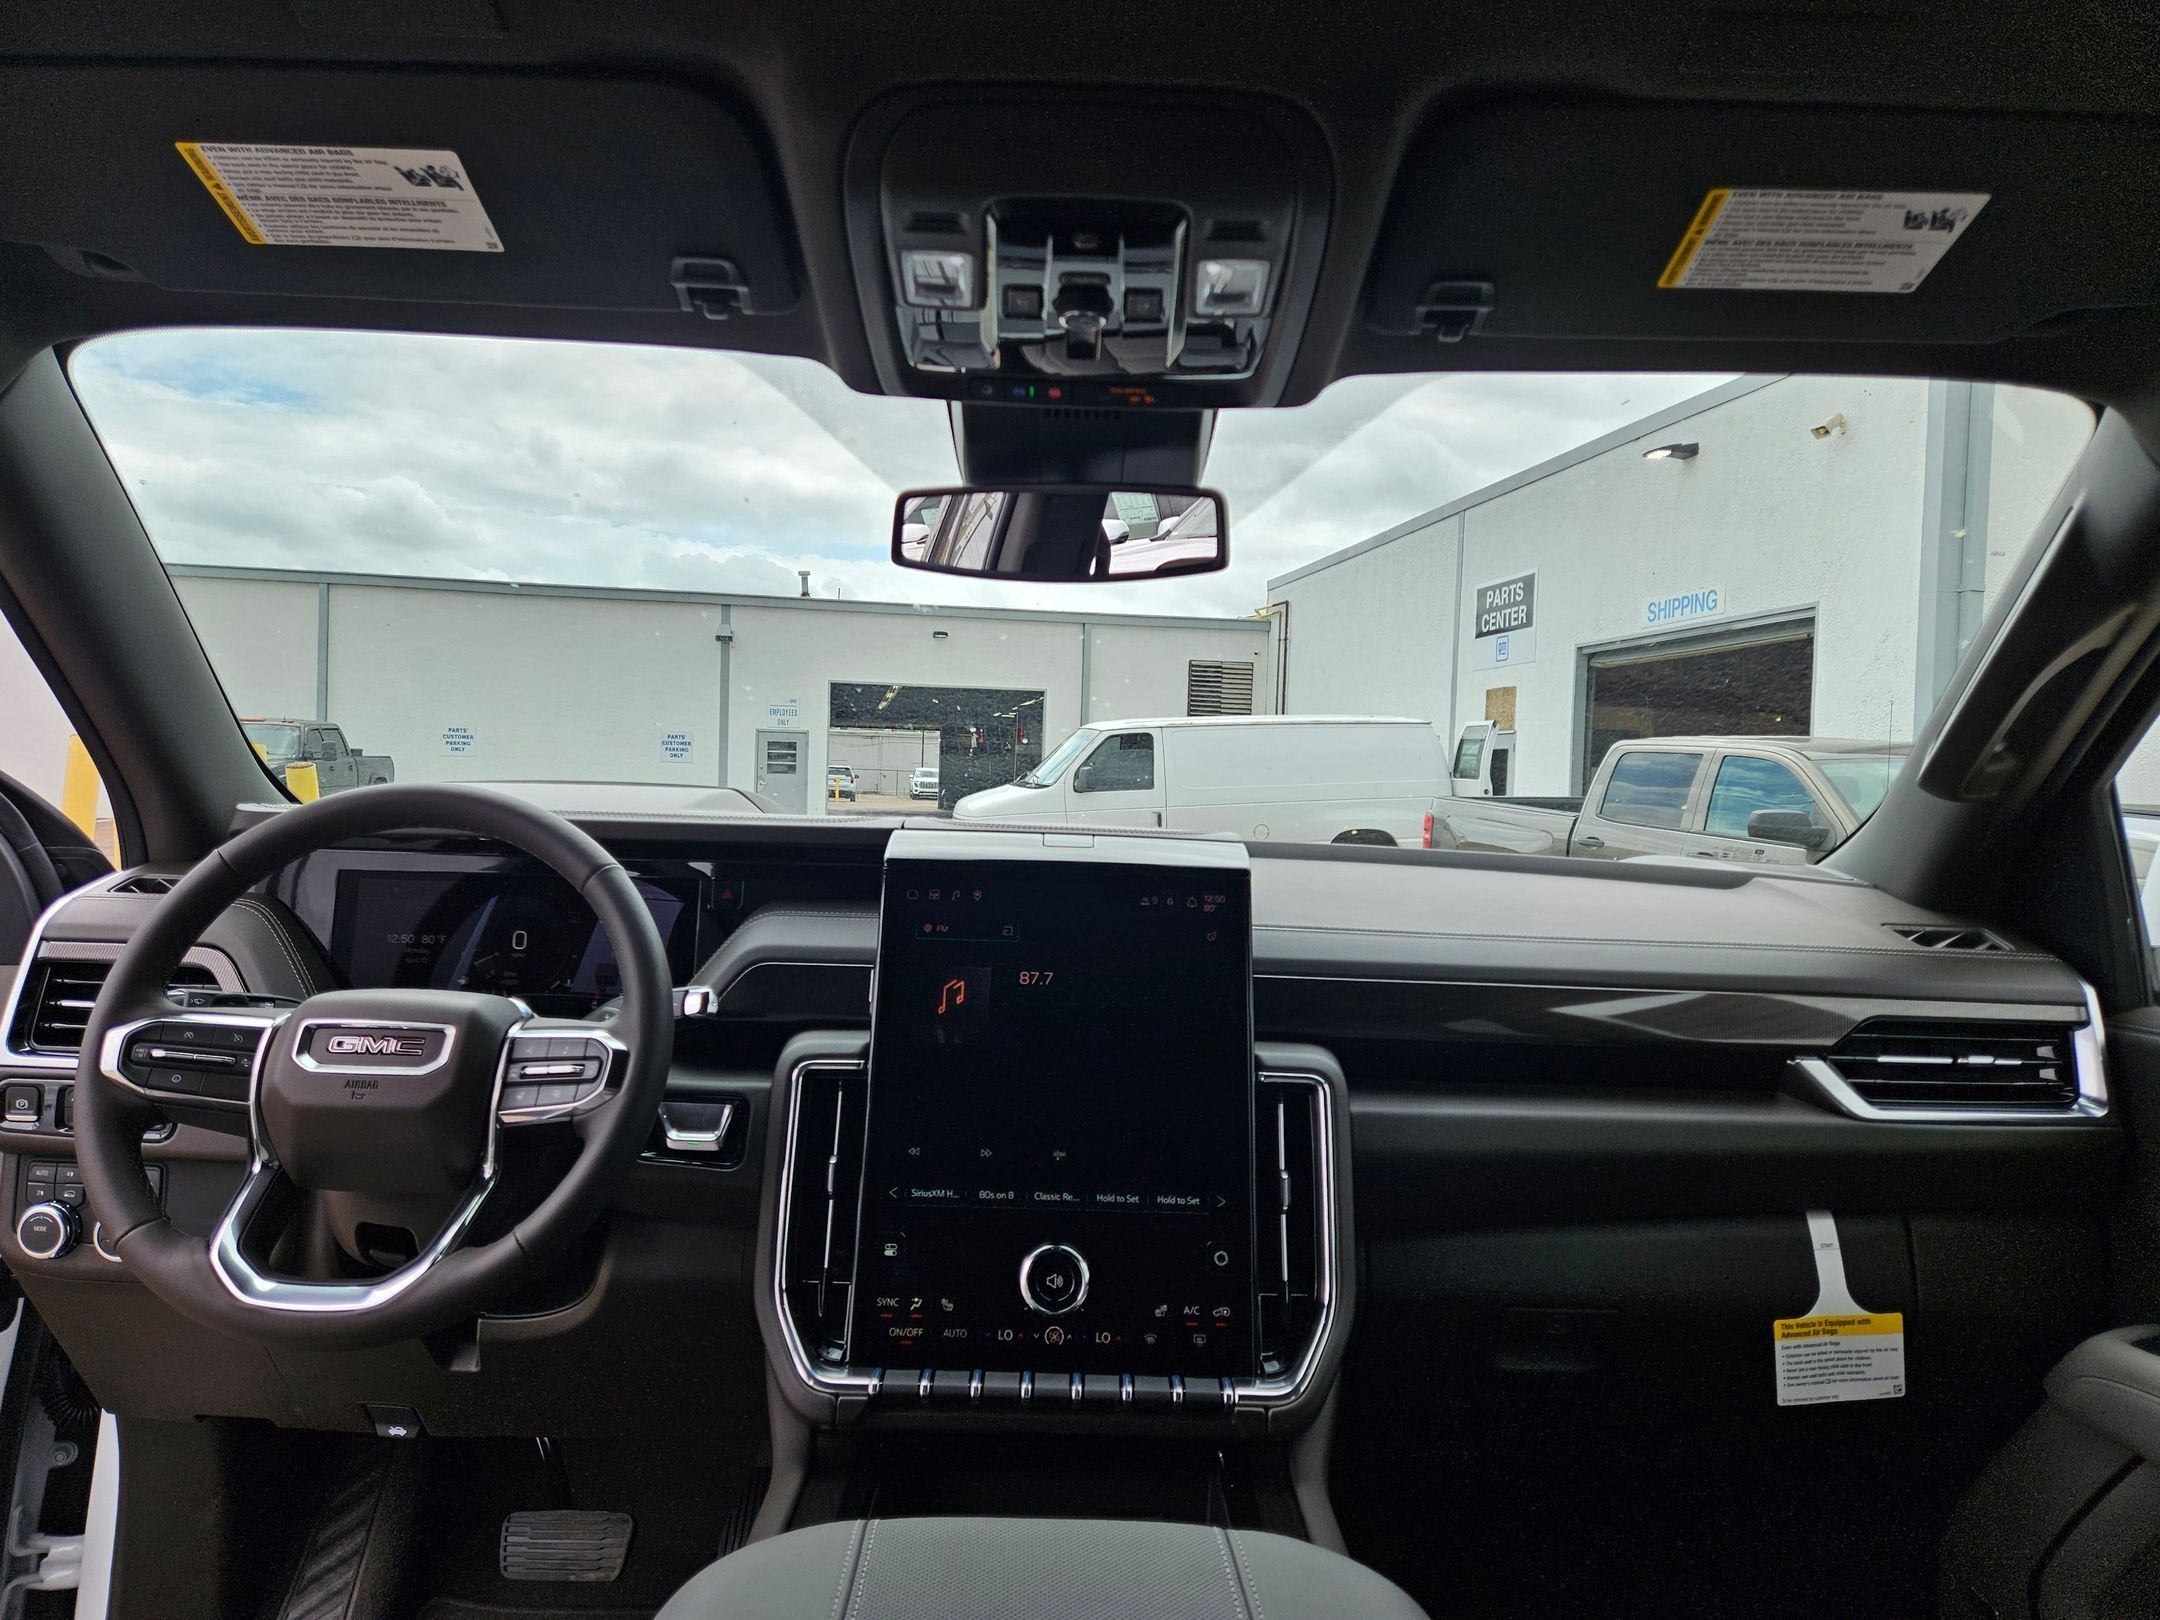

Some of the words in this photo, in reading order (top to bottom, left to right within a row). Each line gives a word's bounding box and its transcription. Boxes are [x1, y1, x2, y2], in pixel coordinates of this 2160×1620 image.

[1486, 582, 1524, 608] PARTS
[1648, 589, 1718, 622] SHIPPING
[1482, 605, 1527, 632] CENTER
[512, 930, 527, 949] 0
[1019, 971, 1054, 985] 87.7
[328, 1036, 425, 1056] GMC
[344, 1080, 379, 1090] AIRBAG
[911, 1189, 945, 1198] SiriusXM
[979, 1190, 995, 1199] 80s
[1008, 1191, 1014, 1199] 8
[1034, 1192, 1061, 1201] Classic
[1097, 1194, 1114, 1202] Hold
[1126, 1194, 1140, 1203] Set
[1157, 1196, 1175, 1204] Hold
[1187, 1197, 1200, 1205] Set
[877, 1298, 899, 1307] SYNC
[1184, 1306, 1200, 1315] A/C
[1824, 1319, 1855, 1328] Equipped
[889, 1328, 924, 1337] ON/OFF
[944, 1329, 967, 1338] AUTO
[998, 1330, 1013, 1341] LO
[1781, 1330, 1811, 1338] Advanced
[1096, 1332, 1111, 1343] LO
